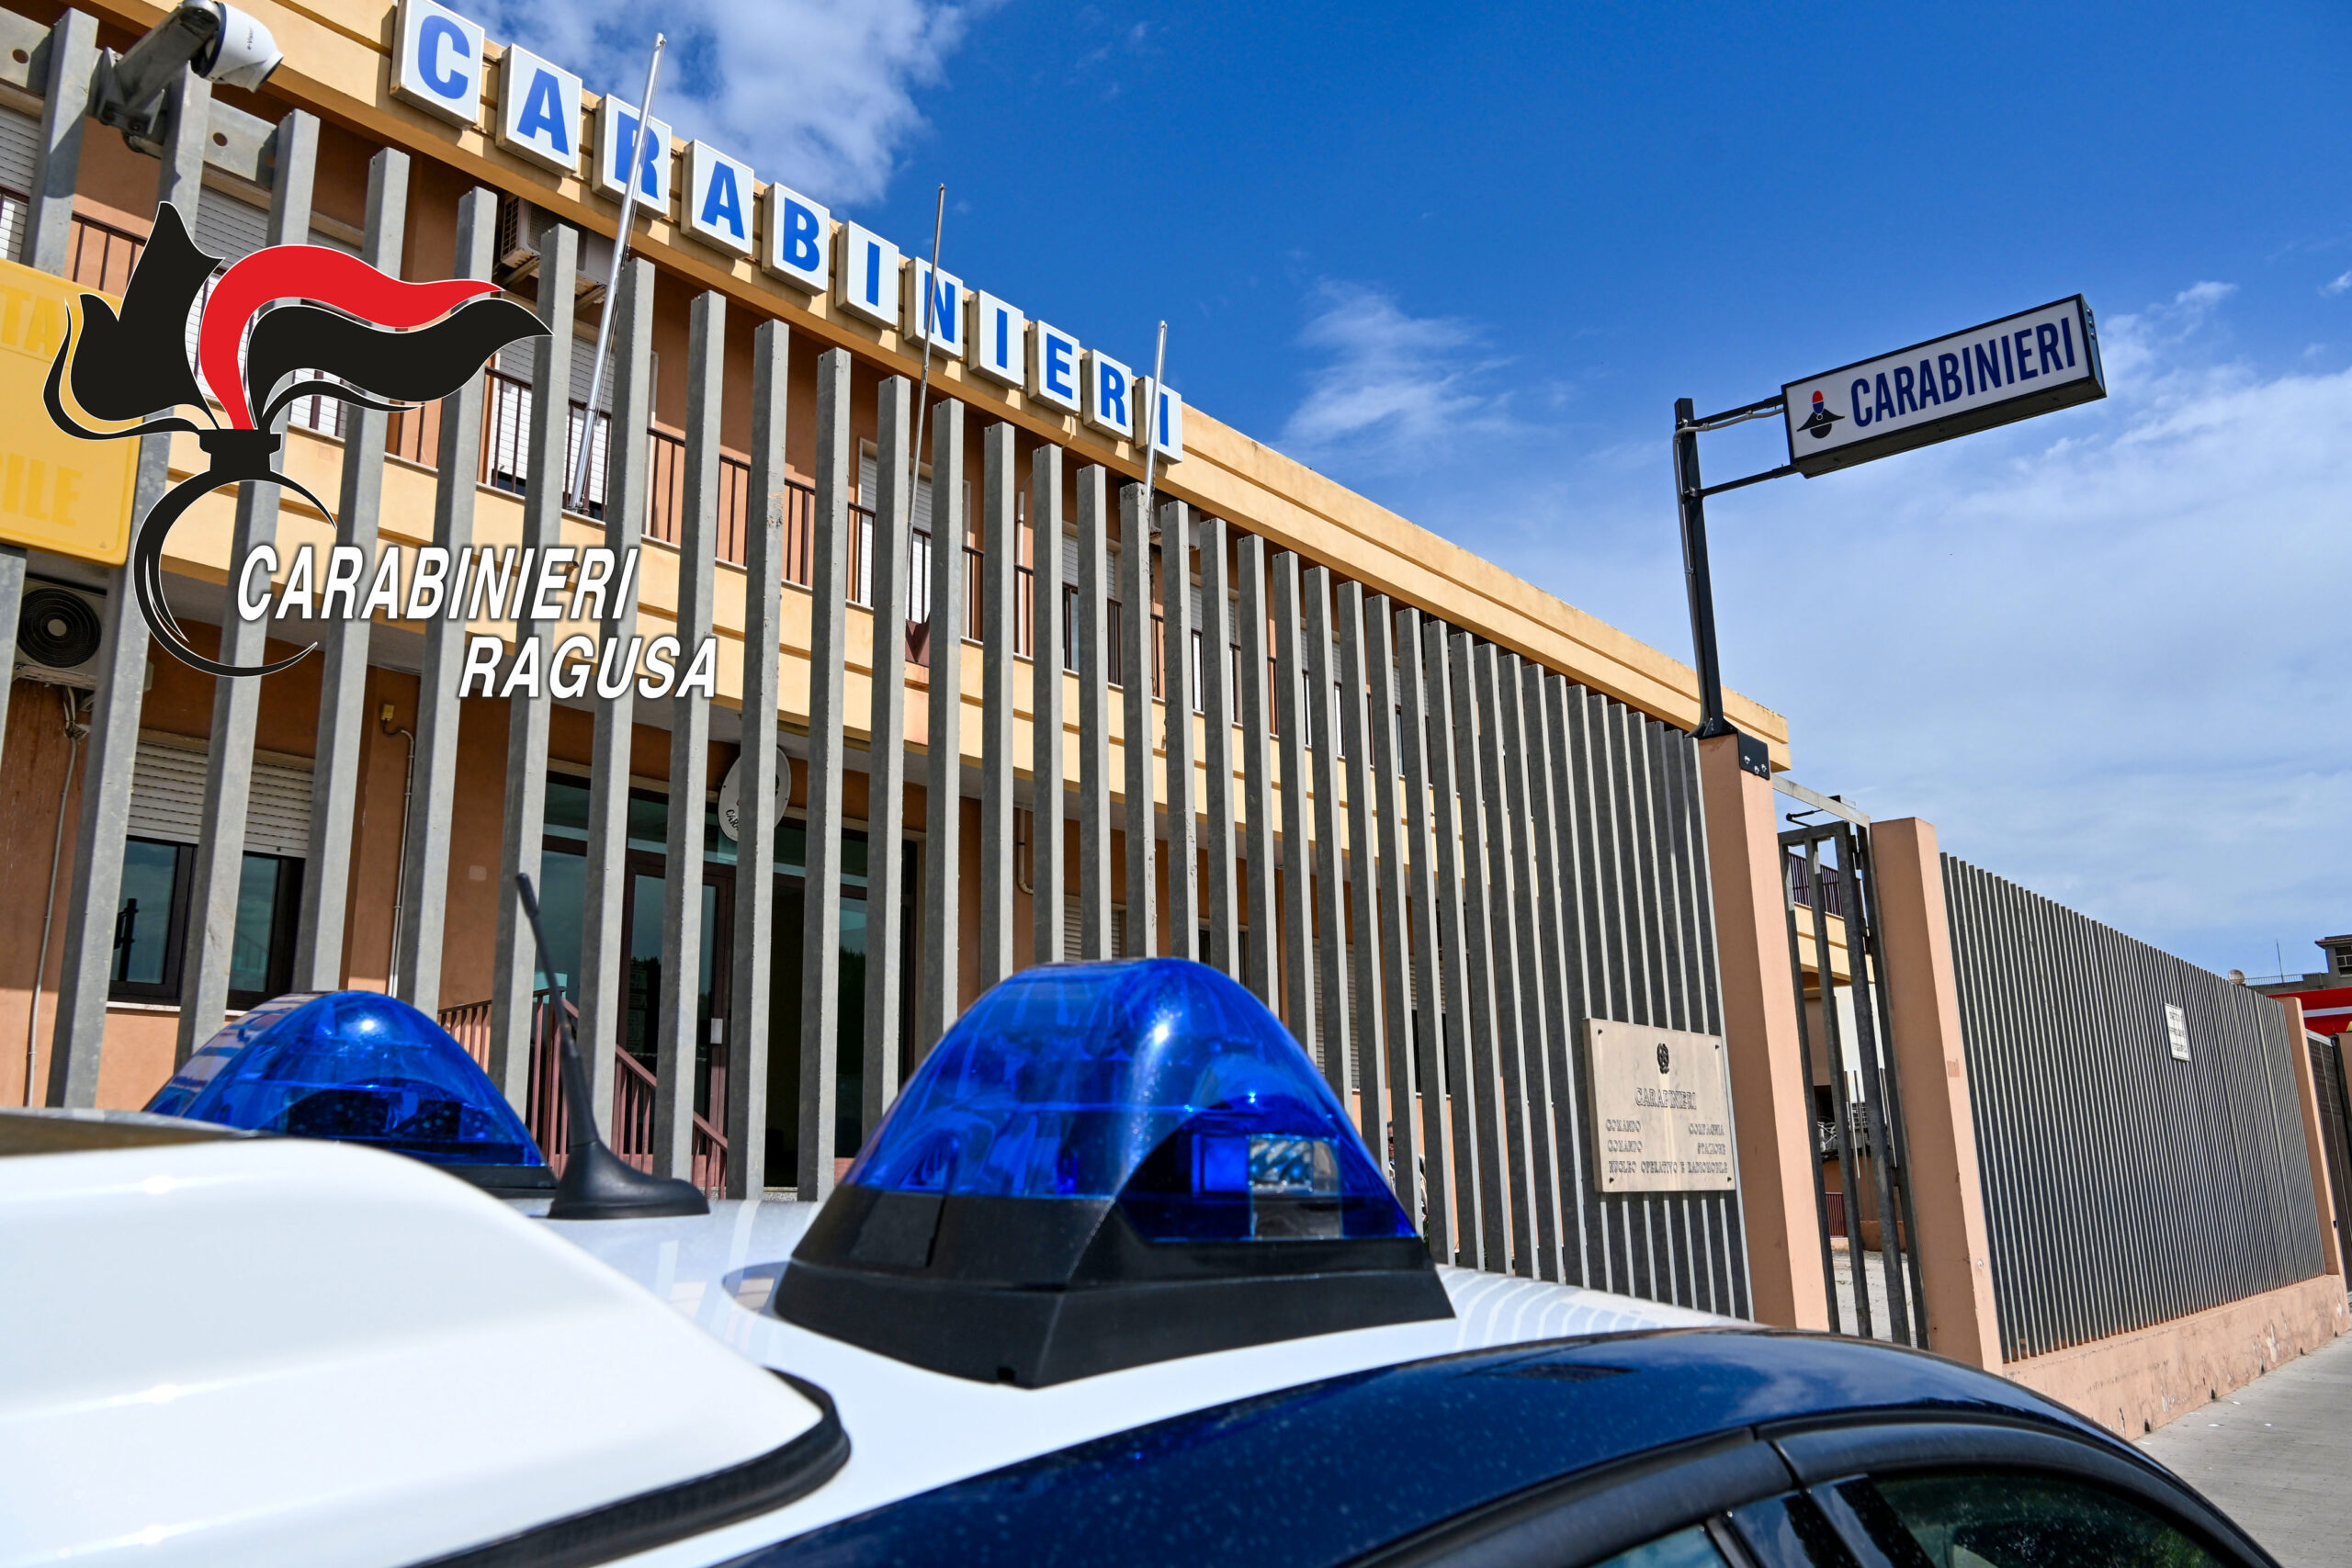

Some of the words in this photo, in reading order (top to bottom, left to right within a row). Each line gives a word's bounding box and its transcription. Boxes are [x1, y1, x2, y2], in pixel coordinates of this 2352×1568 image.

[416, 14, 1170, 448] CARABINIERI
[1850, 317, 2076, 427] CARABINIERI
[1634, 1088, 1697, 1110] CARABINIERI
[1605, 1119, 1642, 1133] COMANDO
[1689, 1122, 1724, 1136] COMPAGNIA
[1607, 1140, 1643, 1153] COMANDO
[1697, 1142, 1726, 1156] STAZIONE
[1609, 1160, 1636, 1174] NUCLEO
[1641, 1160, 1678, 1174] OPERATIVO
[1688, 1161, 1728, 1174] RADIOMOBILE
